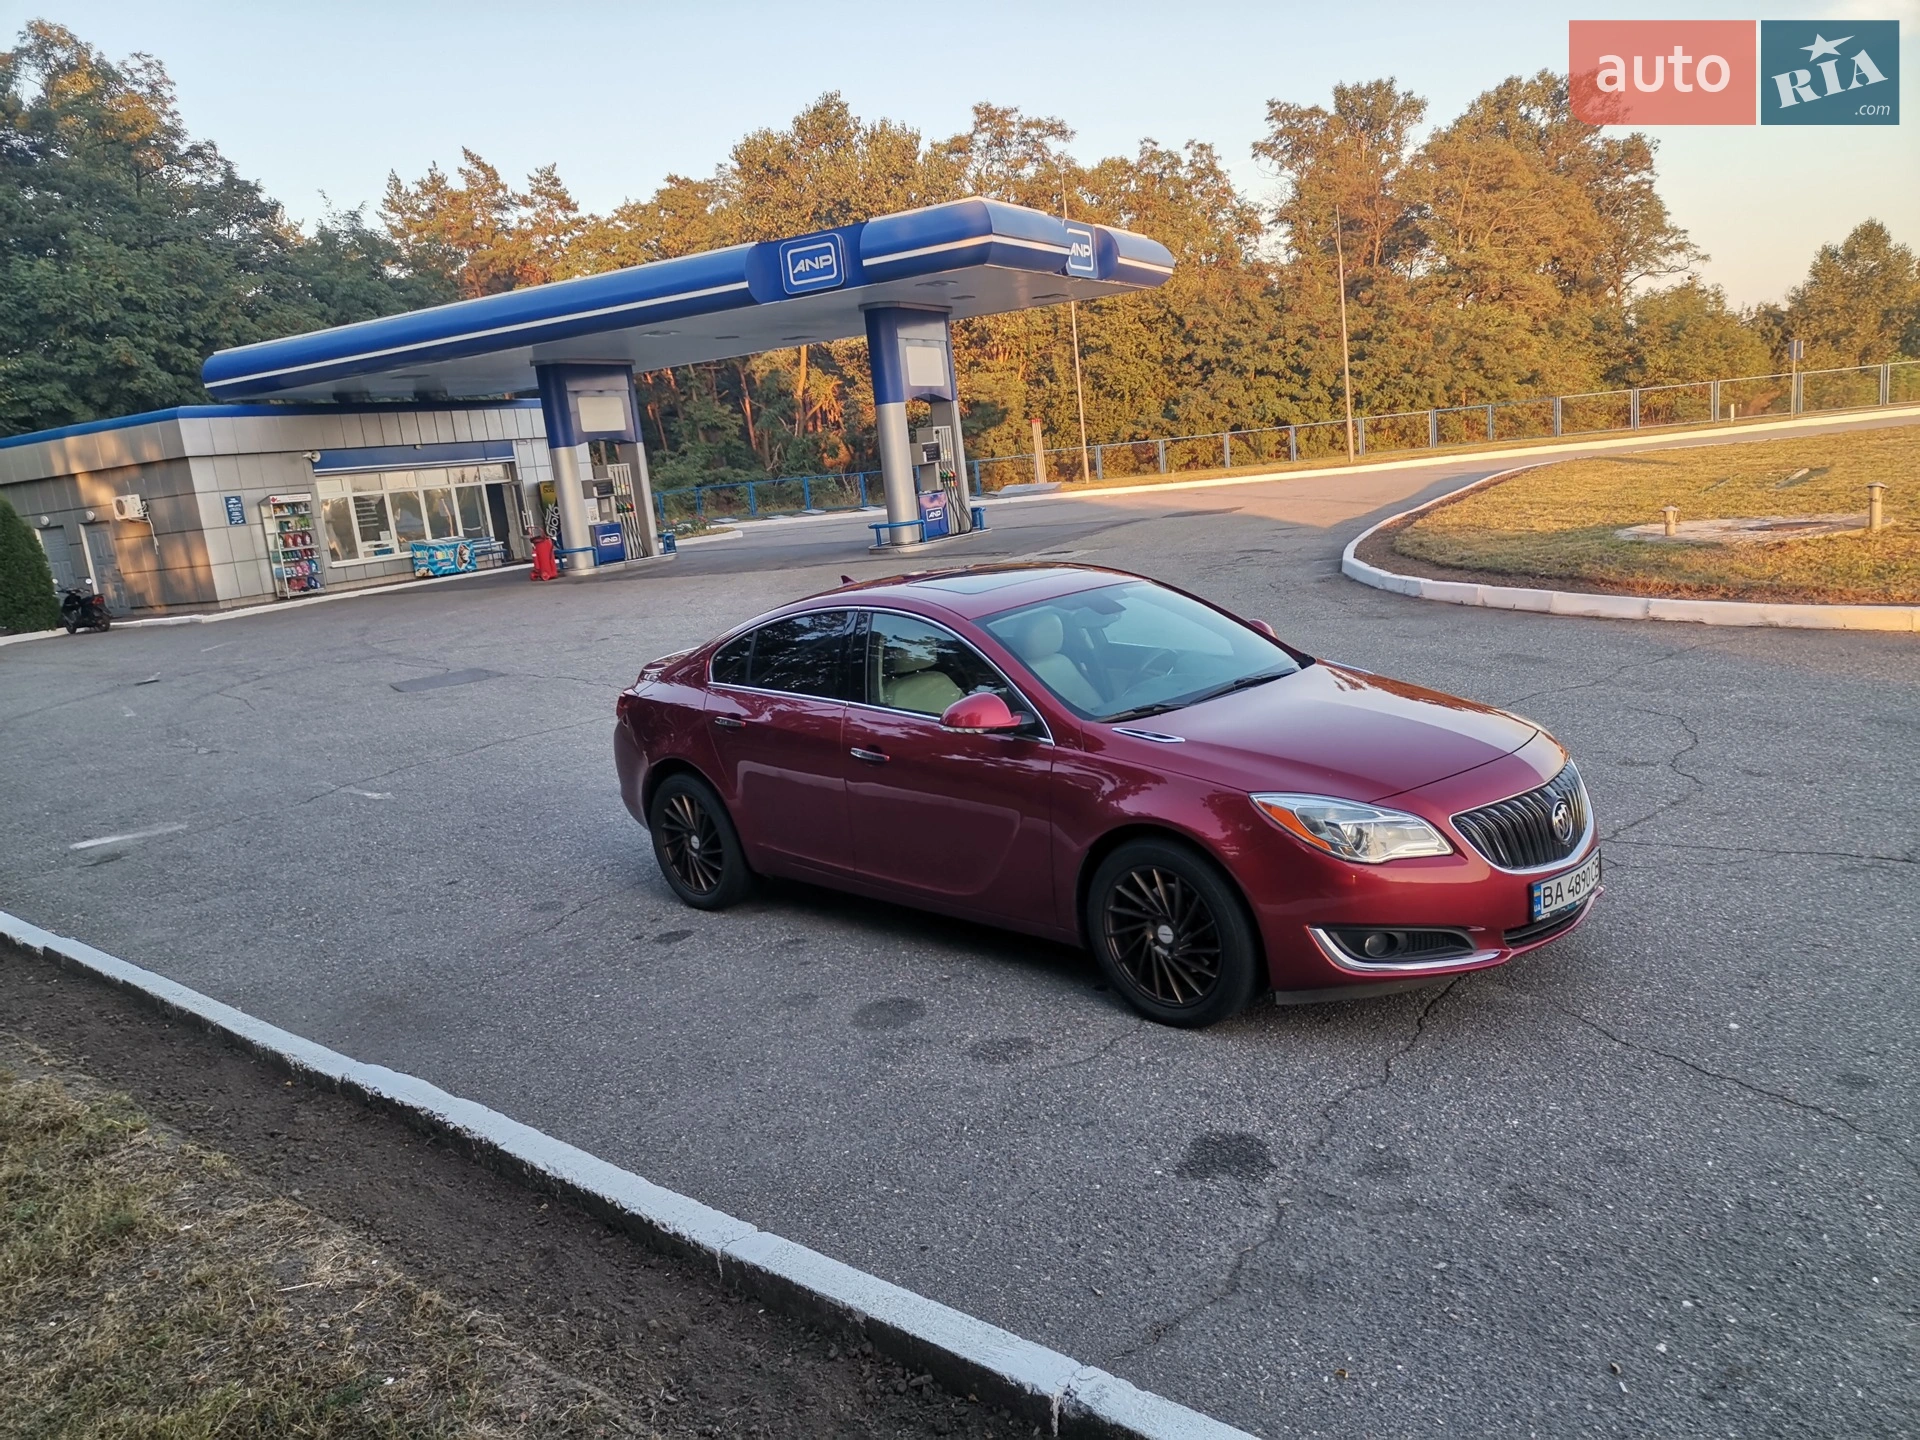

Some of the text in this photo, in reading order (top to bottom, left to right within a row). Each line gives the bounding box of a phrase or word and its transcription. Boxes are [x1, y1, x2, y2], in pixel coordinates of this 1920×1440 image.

[793, 254, 833, 274] ANP
[1543, 882, 1564, 908] BA
[1568, 866, 1591, 897] 4890
